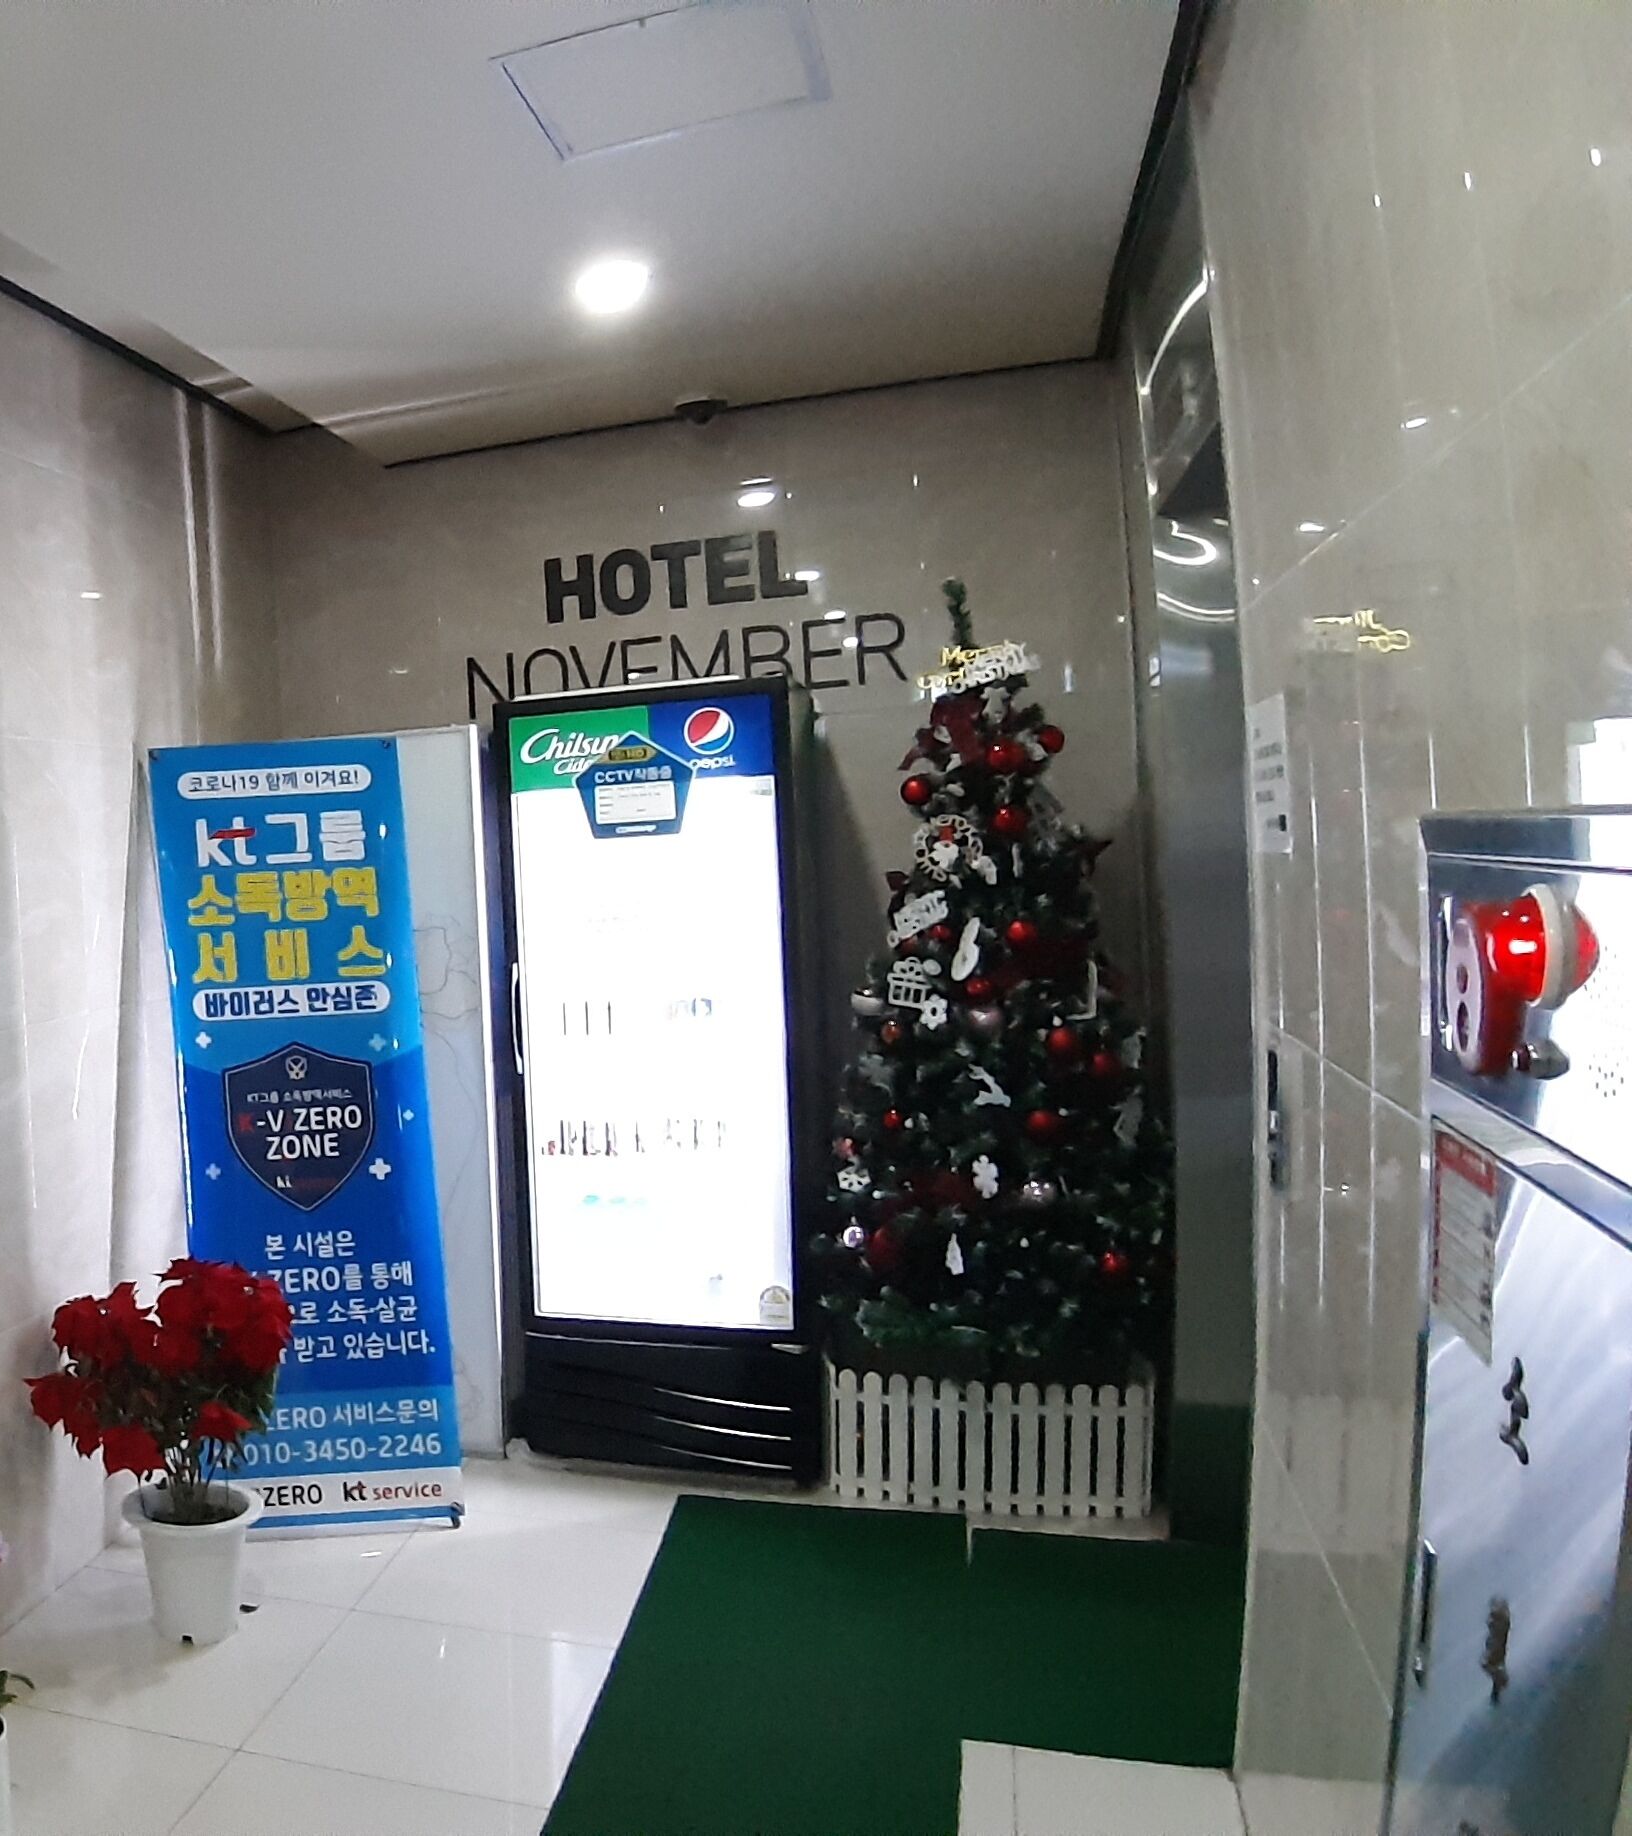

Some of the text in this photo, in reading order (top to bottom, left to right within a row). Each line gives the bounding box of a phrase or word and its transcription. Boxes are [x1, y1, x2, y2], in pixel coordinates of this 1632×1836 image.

[543, 530, 809, 624] HOTEL
[466, 612, 908, 720] NOVEMBER
[520, 728, 621, 763] Chilsun
[188, 769, 359, 793] 코로나19 함께 이겨요!
[195, 810, 366, 867] kt그룹
[187, 867, 380, 926] 소독방역
[192, 925, 388, 983] 서비스
[204, 985, 378, 1018] 바이러스 안심존
[293, 1105, 362, 1131] ZERO
[265, 1132, 340, 1160] ZONE
[264, 1230, 356, 1260] 본 시설은
[370, 1260, 414, 1290] 통해
[293, 1335, 337, 1364] 받고
[343, 1328, 437, 1360] 있습니다.
[333, 1397, 440, 1427] 서비스문의
[243, 1432, 443, 1466] 010-3450-2246
[343, 1480, 368, 1502] kt
[372, 1481, 443, 1500] service
